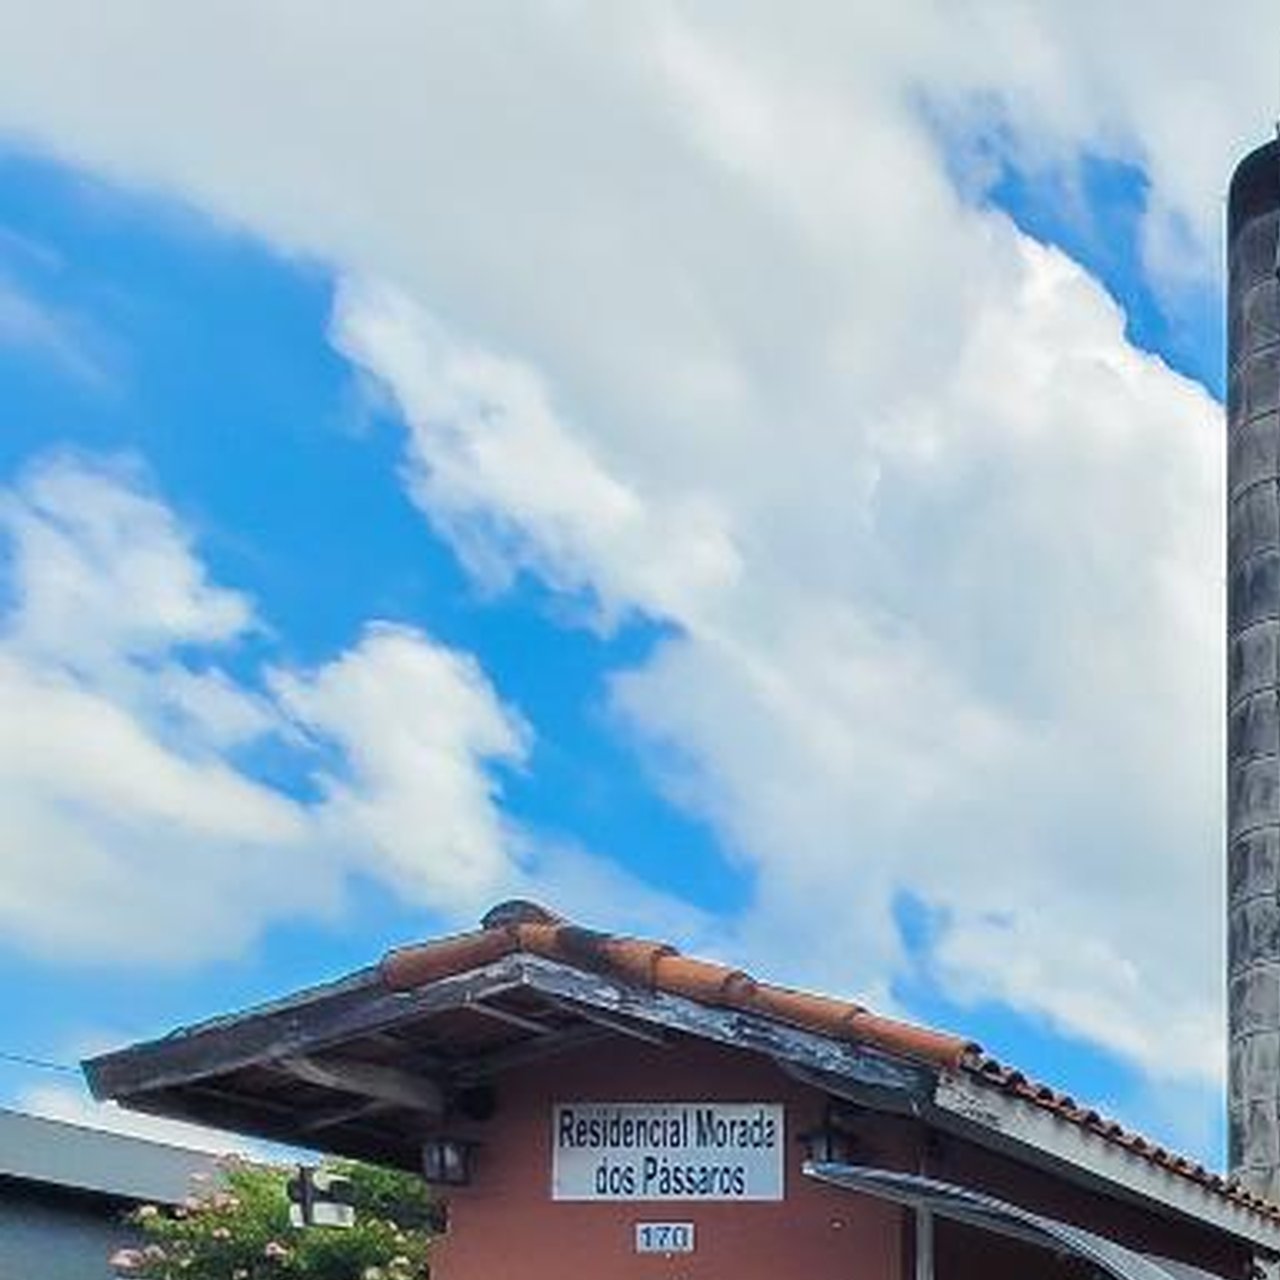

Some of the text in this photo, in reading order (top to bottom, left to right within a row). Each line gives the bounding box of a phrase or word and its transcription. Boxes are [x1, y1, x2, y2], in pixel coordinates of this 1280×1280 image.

[559, 1109, 775, 1148] Residencial Morada
[596, 1155, 745, 1195] dos Pássaros
[640, 1226, 688, 1248] 170
